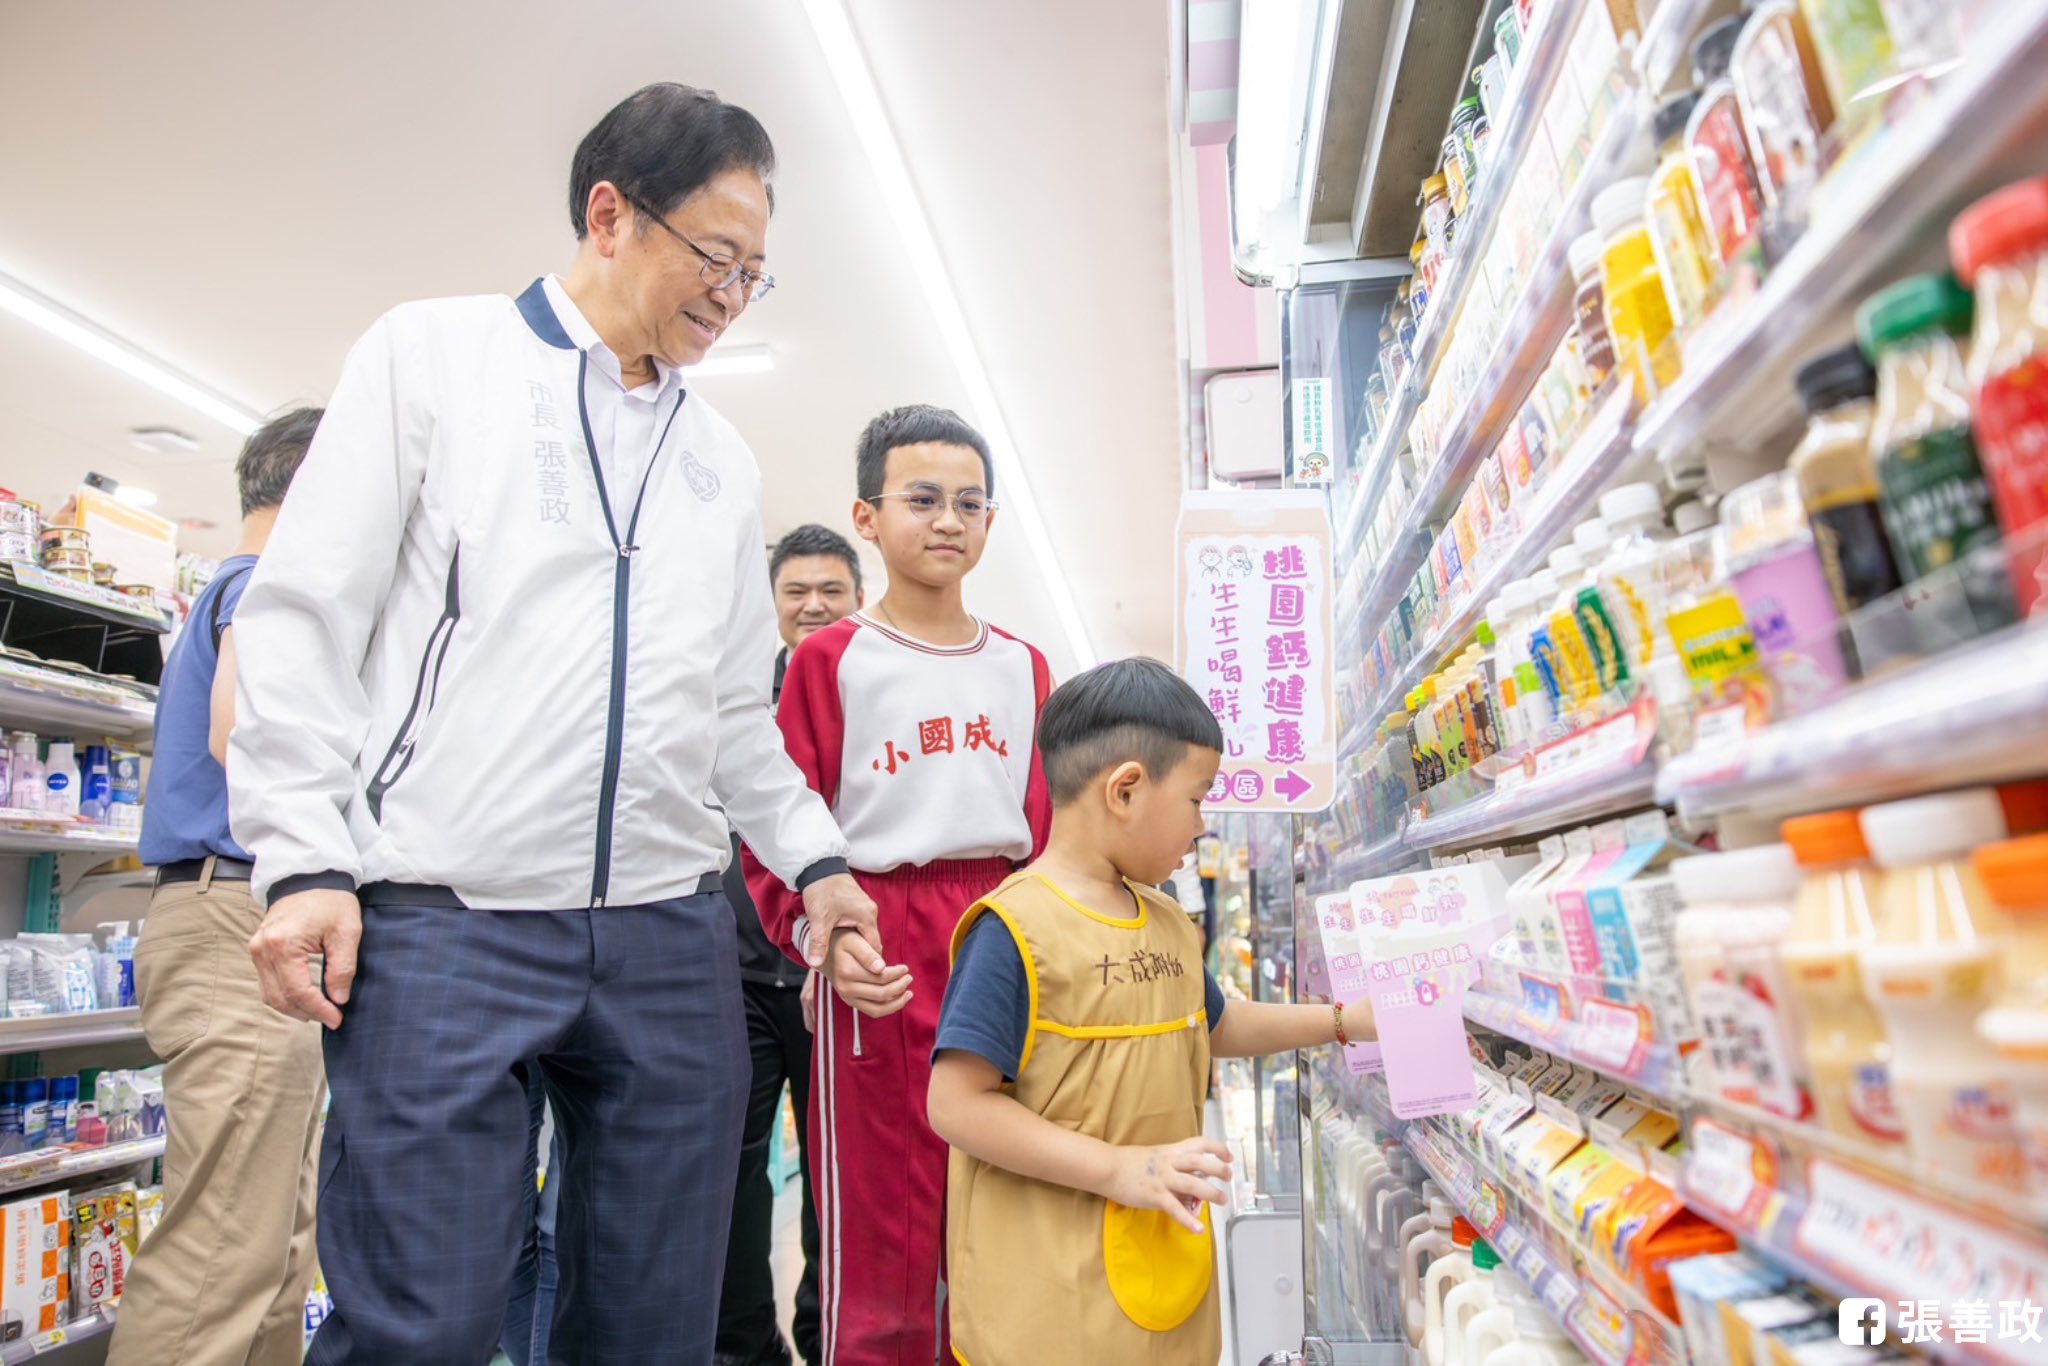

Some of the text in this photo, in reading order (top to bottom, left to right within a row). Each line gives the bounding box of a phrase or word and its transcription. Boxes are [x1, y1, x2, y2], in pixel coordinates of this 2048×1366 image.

[526, 379, 572, 525] 市長 張善政
[1262, 545, 1311, 764] 桃園鈣健康
